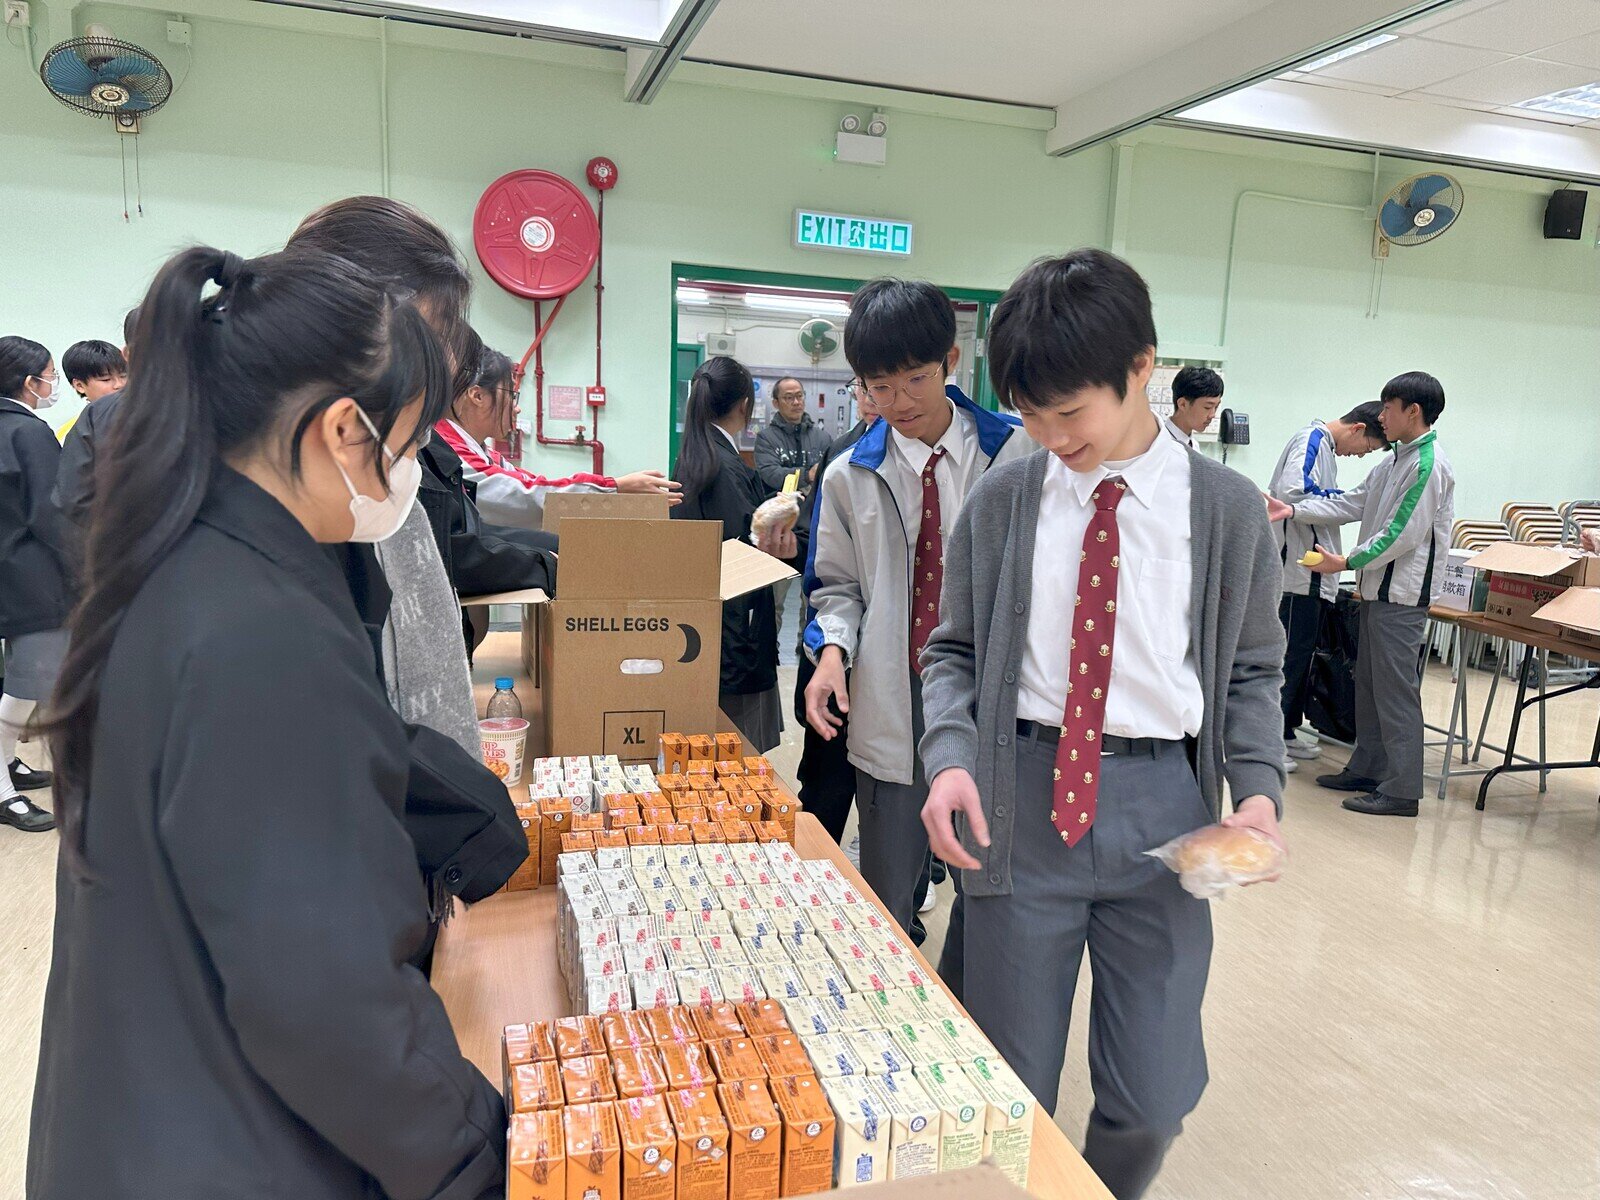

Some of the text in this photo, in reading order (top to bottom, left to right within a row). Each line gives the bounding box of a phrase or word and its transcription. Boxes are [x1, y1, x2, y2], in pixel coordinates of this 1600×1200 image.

[801, 215, 908, 252] EXIT 出口
[566, 617, 670, 632] SHELL EGGS
[623, 727, 645, 745] XL
[482, 742, 497, 750] UP
[483, 750, 505, 758] DLES
